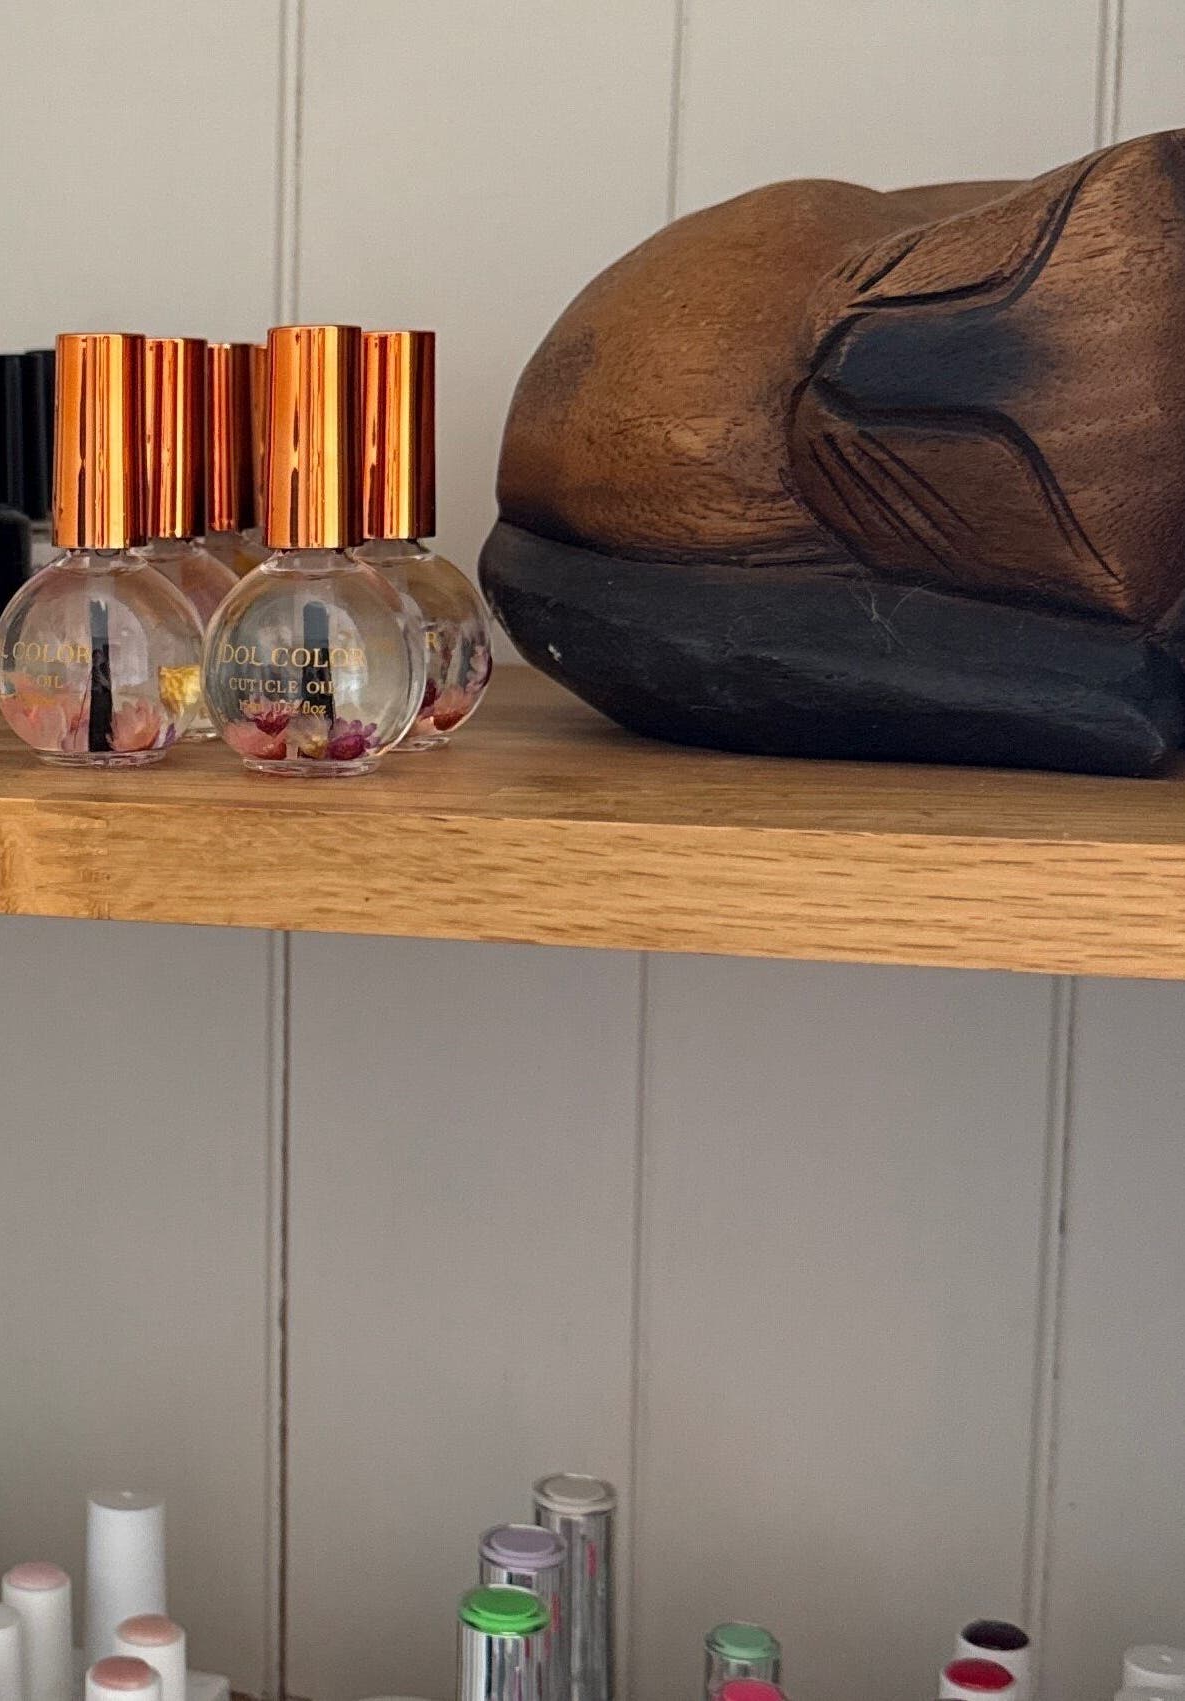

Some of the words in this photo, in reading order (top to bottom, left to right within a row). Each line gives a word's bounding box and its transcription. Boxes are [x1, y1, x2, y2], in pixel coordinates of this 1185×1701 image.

[13, 641, 91, 663] COLOR
[270, 647, 365, 668] COLOR
[37, 674, 63, 689] OIL
[229, 677, 298, 694] CUTICLE
[306, 680, 336, 695] OIL
